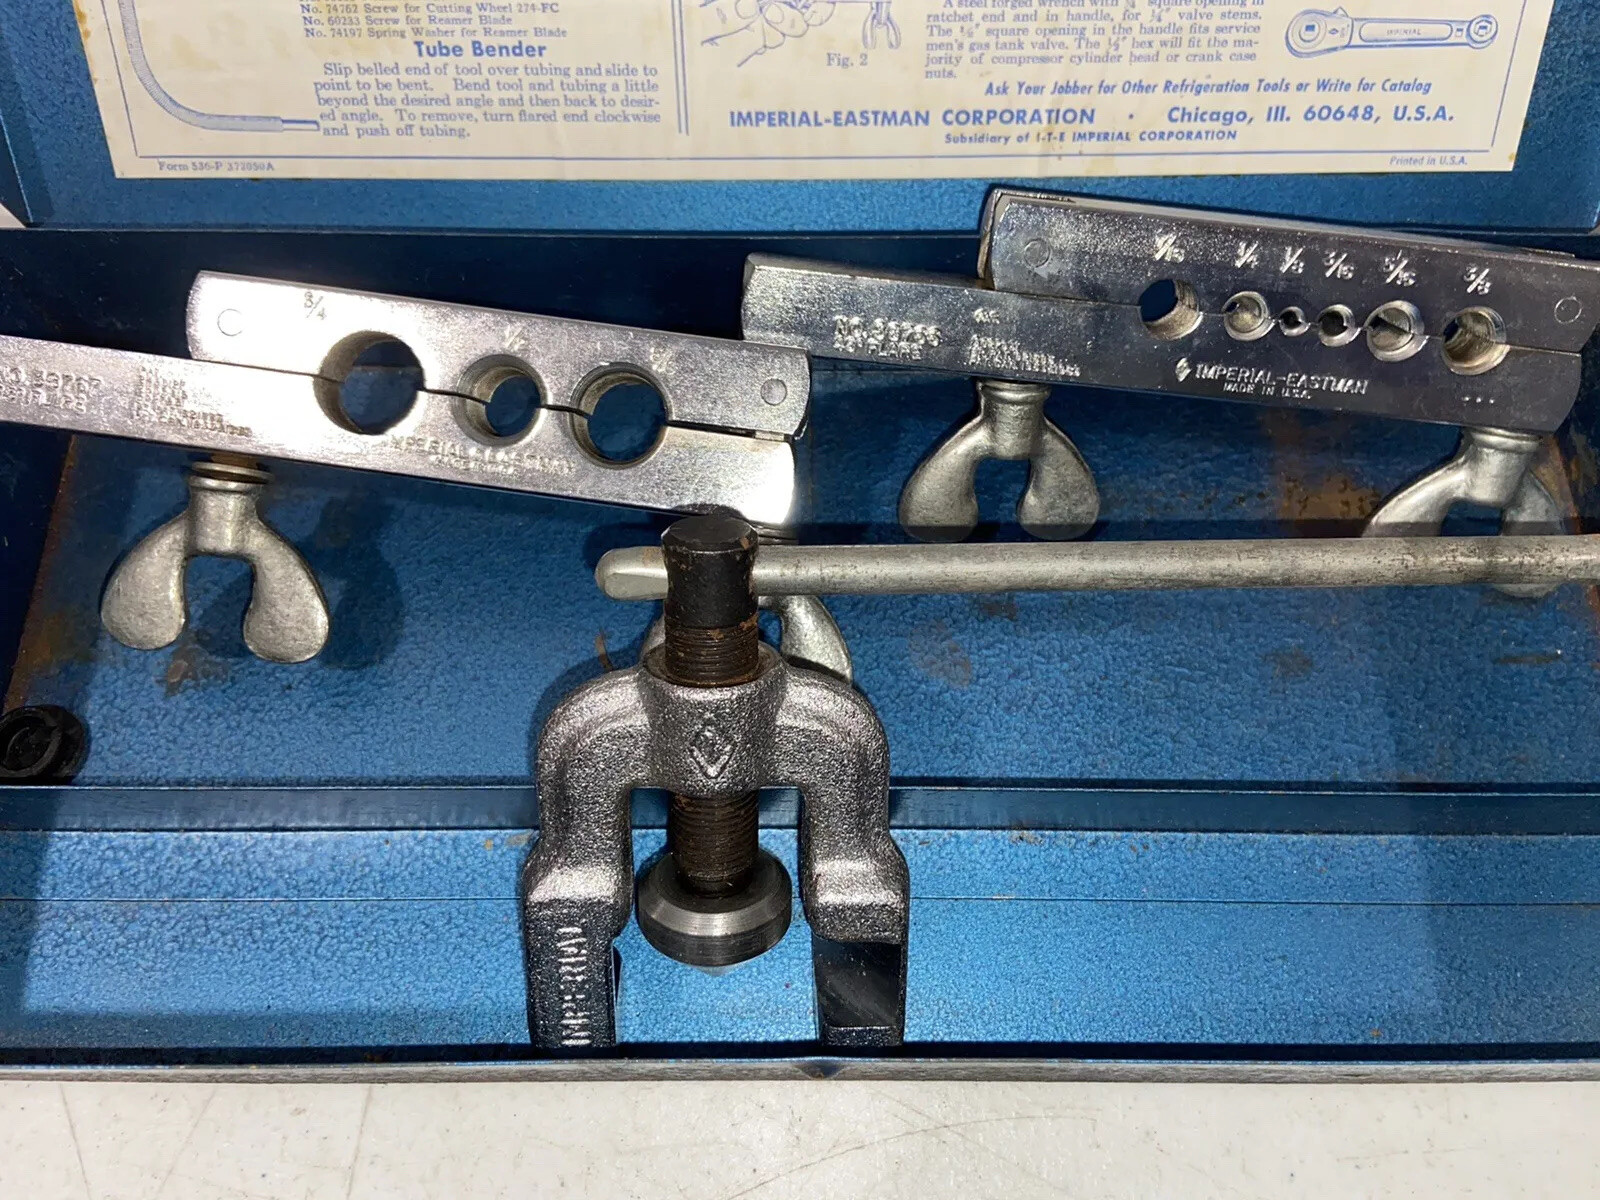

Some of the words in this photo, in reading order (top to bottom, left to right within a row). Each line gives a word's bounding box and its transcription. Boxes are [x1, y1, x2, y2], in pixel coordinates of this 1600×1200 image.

[300, 4, 322, 13] No.
[364, 4, 398, 13] Screw
[404, 3, 420, 13] for
[426, 3, 472, 14] Cutting
[477, 3, 512, 13] Wheel
[926, 10, 974, 22] ratchet
[982, 10, 1005, 22] end
[1013, 10, 1037, 22] and
[1046, 10, 1058, 21] in
[1066, 9, 1114, 22] handle,
[1122, 9, 1141, 21] for
[1178, 9, 1213, 20] valve
[1220, 10, 1262, 20] stems.
[302, 16, 324, 26] No.
[365, 16, 399, 25] Screw
[405, 16, 421, 25] for
[428, 15, 473, 25] Reamer
[479, 15, 512, 25] Blade
[305, 28, 326, 37] No.
[368, 28, 406, 38] Spring
[411, 27, 455, 37] Washer
[461, 27, 477, 37] for
[483, 27, 528, 37] Reamer
[534, 27, 568, 37] Blade
[926, 24, 953, 37] The
[986, 28, 1029, 39] square
[1035, 24, 1087, 38] opening
[1093, 24, 1105, 36] in
[1112, 23, 1133, 35] the
[1140, 23, 1183, 35] handle
[1189, 23, 1210, 35] fits
[1215, 22, 1261, 34] service
[414, 41, 464, 57] Tube
[472, 40, 547, 57] Bender
[926, 38, 964, 51] men's
[969, 40, 990, 52] gas
[995, 38, 1025, 50] tank
[1030, 38, 1068, 50] valve.
[1074, 36, 1100, 50] The
[1132, 36, 1154, 48] hex
[1159, 36, 1182, 48] will
[1188, 36, 1202, 48] fit
[1207, 36, 1228, 47] the
[1233, 38, 1259, 47] ma-
[826, 53, 854, 68] Fig.
[860, 53, 868, 66] 2
[925, 53, 962, 67] jority
[970, 53, 984, 64] of
[991, 55, 1064, 66] compressor
[1070, 52, 1123, 65] cylinder
[1166, 54, 1180, 62] or
[1186, 51, 1222, 62] crank
[1229, 53, 1257, 62] case
[323, 62, 353, 78] Slip
[357, 62, 399, 75] belled
[405, 63, 430, 75] end
[434, 62, 448, 75] of
[455, 62, 482, 75] tool
[488, 66, 519, 76] over
[524, 62, 570, 79] tubing
[576, 63, 602, 76] and
[606, 62, 638, 76] slide
[643, 64, 658, 76] to
[925, 69, 957, 79] nuts.
[314, 78, 351, 95] point
[356, 80, 371, 91] to
[376, 78, 392, 91] be
[397, 78, 433, 91] bent.
[453, 77, 490, 91] Bend
[496, 78, 523, 91] tool
[529, 79, 554, 91] and
[560, 78, 607, 93] tubing
[612, 82, 620, 91] a
[625, 79, 659, 92] little
[984, 81, 1010, 96] Ask
[1017, 81, 1046, 95] Your
[1050, 80, 1093, 95] Jobber
[1098, 80, 1117, 95] for
[1122, 79, 1158, 94] Other
[1163, 78, 1250, 96] Refrigeration
[1256, 78, 1290, 93] Tools
[1296, 81, 1310, 92] or
[1316, 78, 1351, 92] Write
[1357, 78, 1376, 93] for
[1381, 77, 1432, 95] Catalog
[317, 94, 368, 108] beyond
[374, 94, 396, 106] the
[401, 94, 450, 106] desired
[456, 94, 494, 109] angle
[498, 94, 525, 107] and
[529, 94, 561, 107] then
[564, 94, 597, 107] back
[601, 96, 616, 107] to
[621, 94, 660, 107] desir-
[320, 109, 336, 121] ed
[341, 109, 384, 124] angle.
[395, 109, 416, 121] To
[421, 112, 479, 123] remove,
[483, 111, 515, 122] turn
[518, 109, 558, 122] flared
[563, 110, 589, 122] end
[594, 110, 661, 123] clockwise
[730, 110, 930, 127] IMPERIAL-EASTMAN
[942, 108, 1096, 126] CORPORATION
[1167, 106, 1254, 126] Chicago,
[1266, 105, 1291, 122] Ill.
[1303, 105, 1381, 124] 60648,
[1393, 105, 1454, 121] U.S.A.
[323, 124, 349, 136] and
[356, 125, 390, 139] push
[396, 124, 415, 136] off
[420, 124, 471, 138] tubing.
[945, 133, 1010, 145] Subsidiary
[1017, 132, 1030, 143] of
[1072, 131, 1131, 142] IMPERIAL
[1139, 130, 1238, 141] CORPORATION
[158, 160, 189, 171] Form
[1389, 156, 1425, 166] Printed
[1427, 156, 1436, 165] in
[1439, 155, 1468, 165] U.S.A.
[1195, 362, 1369, 394] IMPERIAL-EASTMAN
[1223, 382, 1255, 394] MADE
[1262, 386, 1274, 396] IN
